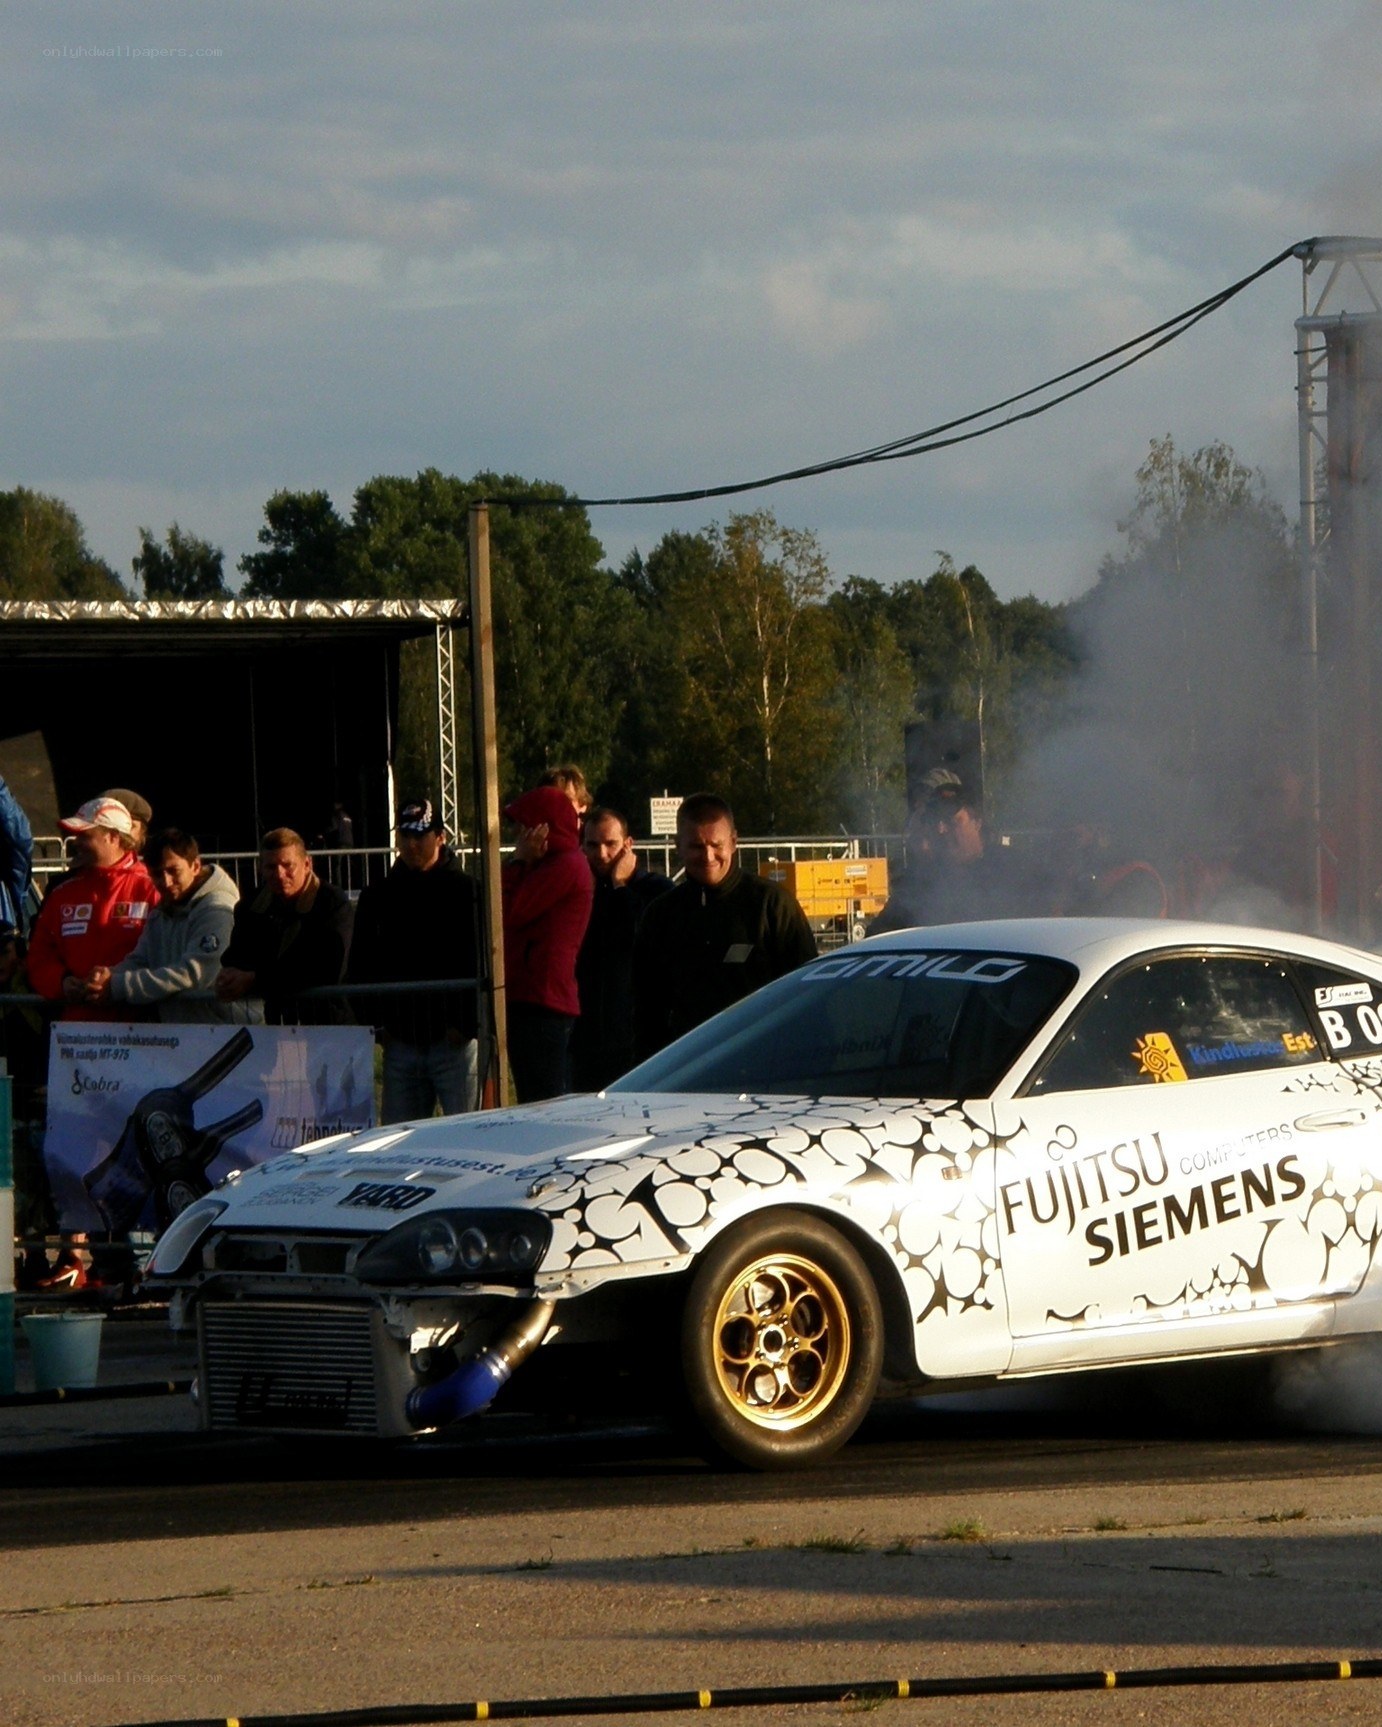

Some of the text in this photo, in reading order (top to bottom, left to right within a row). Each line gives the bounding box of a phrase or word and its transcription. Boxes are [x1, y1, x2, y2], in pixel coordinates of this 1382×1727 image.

[1317, 1009, 1352, 1050] B
[98, 1048, 130, 1061] MT-975
[83, 1076, 120, 1093] Cobra
[1179, 1124, 1293, 1175] COMPUTERS
[336, 1181, 437, 1210] YARD
[1001, 1132, 1169, 1236] FUJITSU
[1085, 1155, 1306, 1266] SIEMENS
